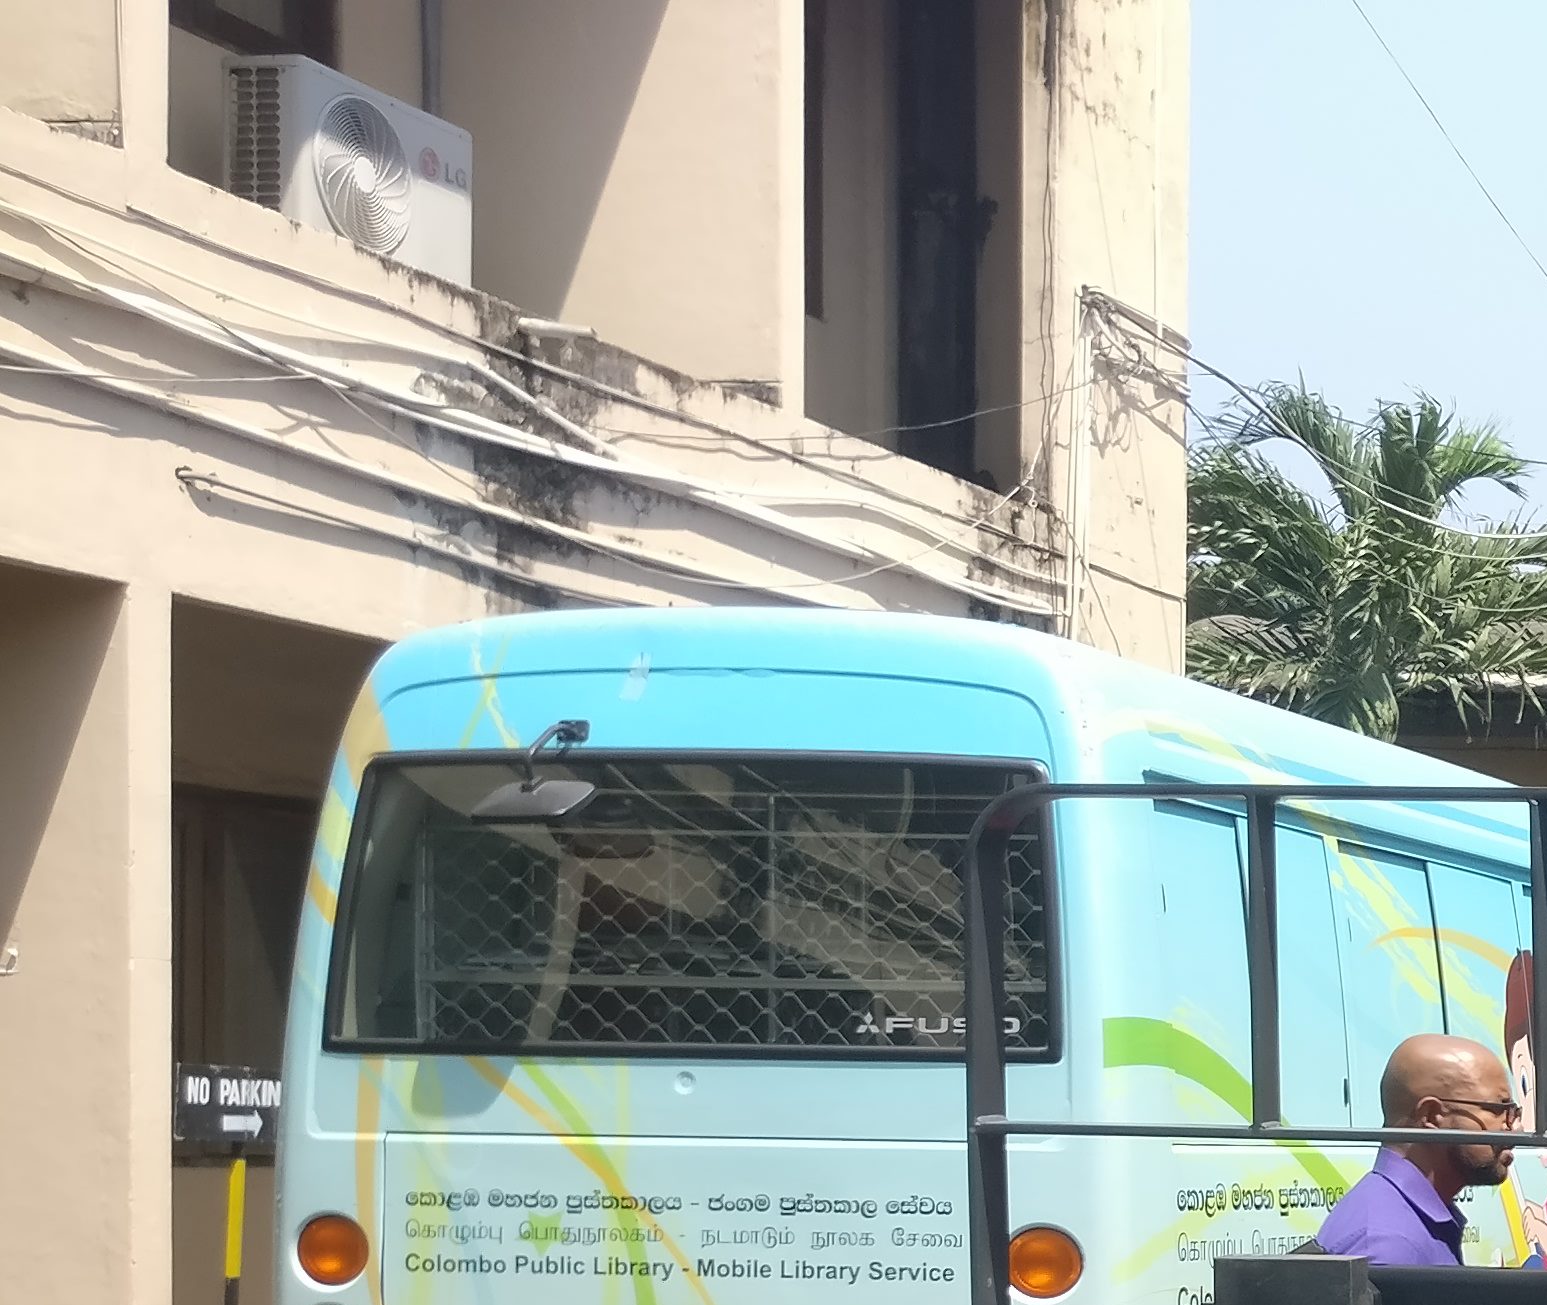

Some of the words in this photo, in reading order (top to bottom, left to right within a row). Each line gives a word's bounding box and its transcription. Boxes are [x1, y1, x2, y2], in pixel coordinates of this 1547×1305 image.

[444, 163, 468, 190] LG
[187, 1076, 211, 1105] NO
[220, 1078, 281, 1107] PARKIN
[405, 1188, 479, 1211] කොළඹ
[487, 1188, 558, 1209] මහජන
[405, 1253, 507, 1274] Colombo
[515, 1255, 586, 1276] Public
[594, 1257, 673, 1281] Library
[697, 1259, 772, 1278] Mobile
[781, 1261, 860, 1285] Library
[869, 1262, 955, 1281] Service
